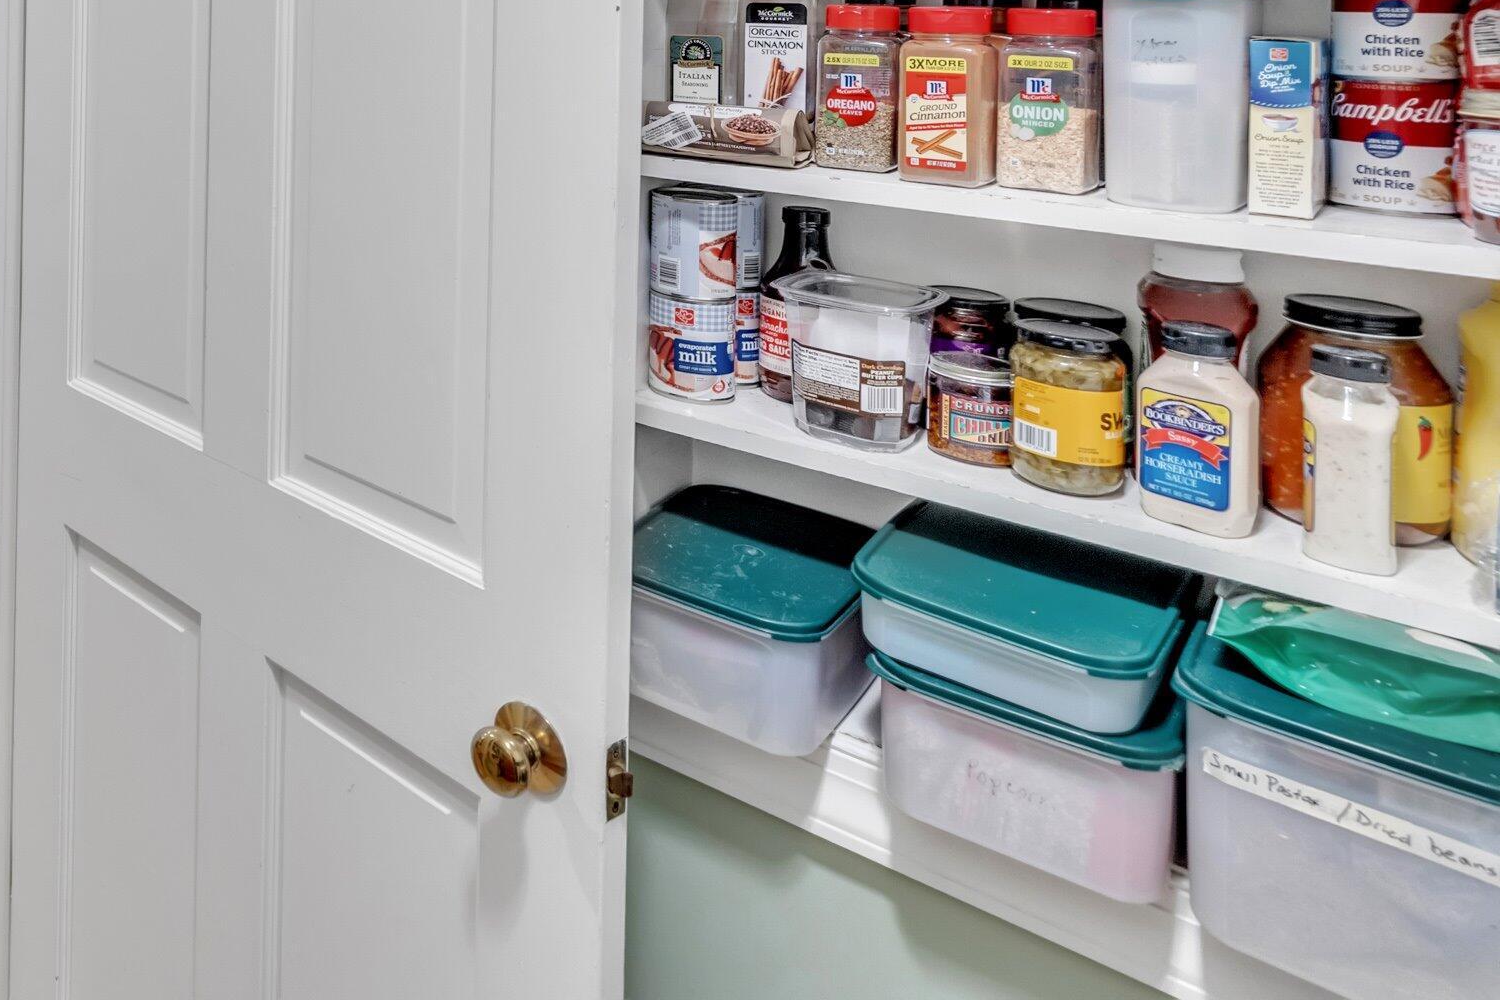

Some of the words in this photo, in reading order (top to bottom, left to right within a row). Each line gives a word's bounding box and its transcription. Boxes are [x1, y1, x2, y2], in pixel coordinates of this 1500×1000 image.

[758, 8, 794, 17] McCormick
[750, 28, 799, 38] ORGANIC
[747, 40, 804, 50] CINNAMON
[1365, 34, 1420, 45] Chicken
[1361, 47, 1391, 57] with
[1394, 46, 1424, 58] Rice
[909, 58, 925, 70] 3X
[926, 59, 965, 67] MORE
[1263, 63, 1297, 73] Onion
[1372, 63, 1413, 73] SOUP
[678, 71, 712, 80] ITALIAN
[1258, 70, 1284, 81] Soup
[1260, 80, 1279, 89] Dip
[1281, 77, 1302, 86] Mix
[827, 98, 875, 111] OREGANO
[919, 103, 957, 112] GROUND
[909, 110, 966, 121] Cinnamon
[1012, 105, 1065, 121] ONION
[1021, 120, 1056, 128] MINCED
[1254, 133, 1281, 143] Onion
[1282, 134, 1305, 145] Soup
[1356, 164, 1412, 178] Chicken
[1352, 177, 1381, 188] with
[1384, 178, 1415, 191] Rice
[1362, 194, 1403, 205] SOUP
[678, 342, 717, 352] evaporated
[768, 344, 791, 357] SAUC
[678, 351, 717, 365] milk
[861, 372, 887, 380] BUTTER
[955, 399, 1011, 416] CRUNCH
[1145, 406, 1225, 437] BOOKBINDER'S
[1167, 430, 1198, 447] Sassy
[1159, 452, 1204, 471] CREAMY
[1144, 455, 1222, 485] HORSERADISH
[1165, 472, 1198, 488] SAUCE
[1209, 752, 1258, 786] Small
